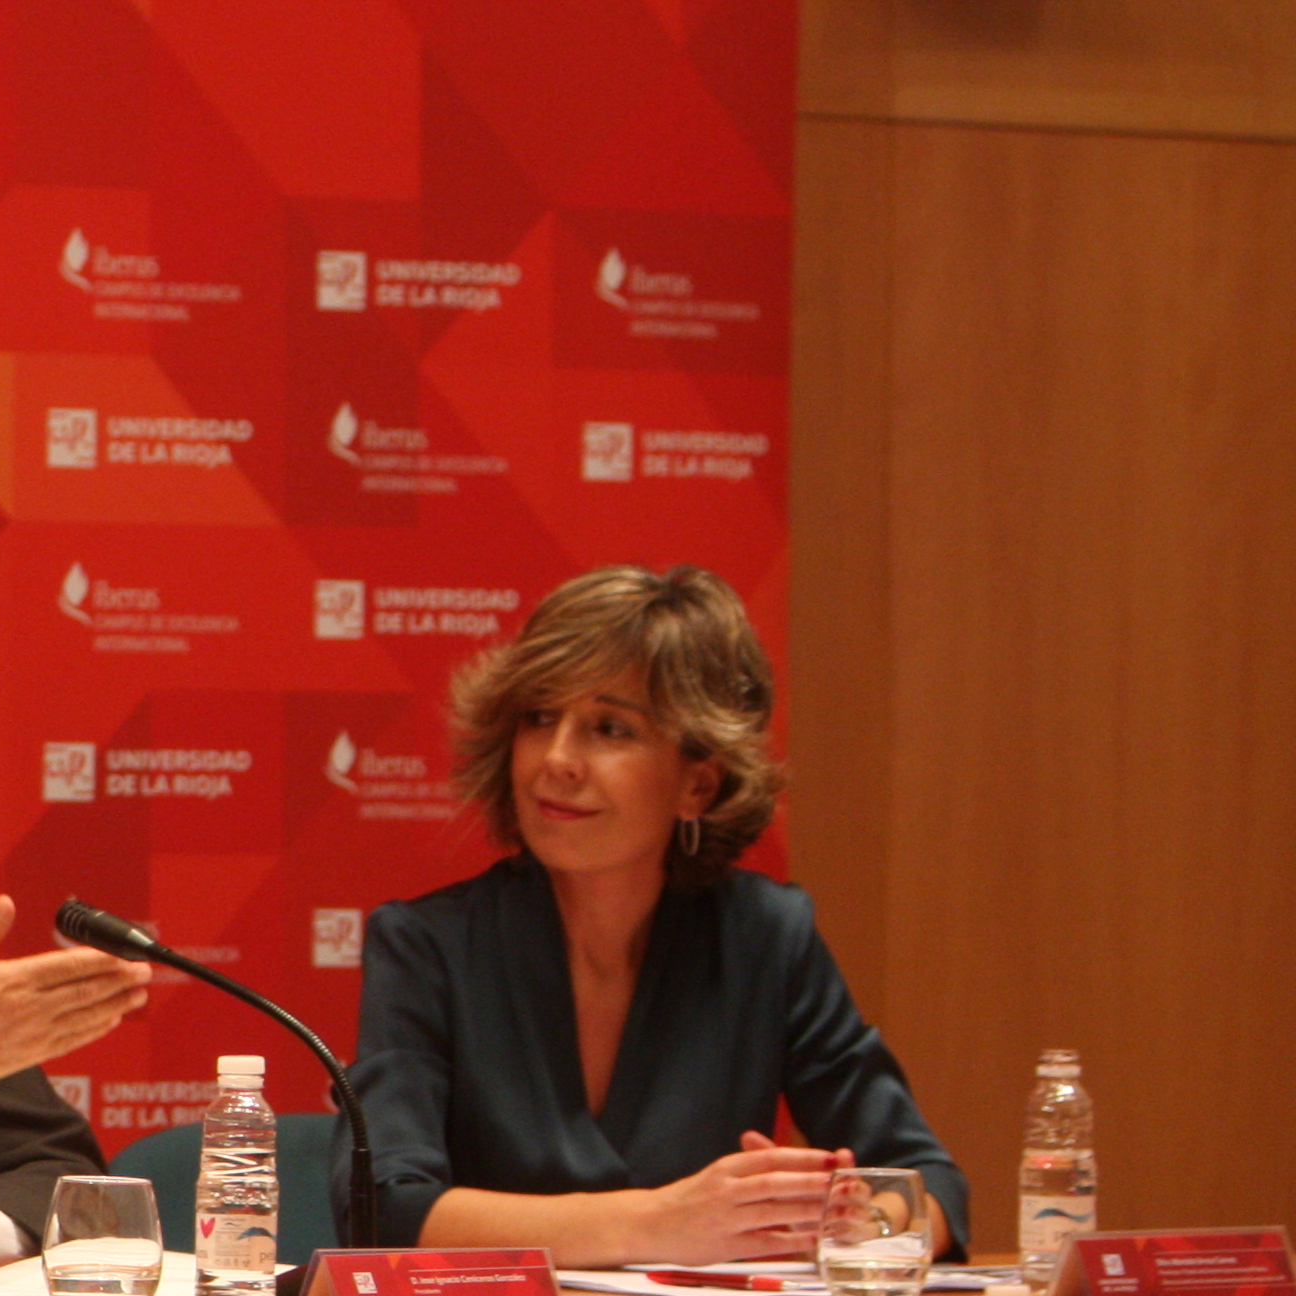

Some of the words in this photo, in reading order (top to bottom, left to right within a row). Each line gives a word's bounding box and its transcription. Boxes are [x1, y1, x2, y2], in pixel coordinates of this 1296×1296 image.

[107, 417, 253, 441] UNIVERSIDAD
[107, 442, 136, 463] DE
[142, 443, 171, 463] LA
[174, 443, 232, 468] RIOJA
[107, 750, 251, 771] UNIVERSIDAD
[107, 774, 137, 795] DE
[141, 775, 170, 796] LA
[173, 775, 232, 799] RIOJA
